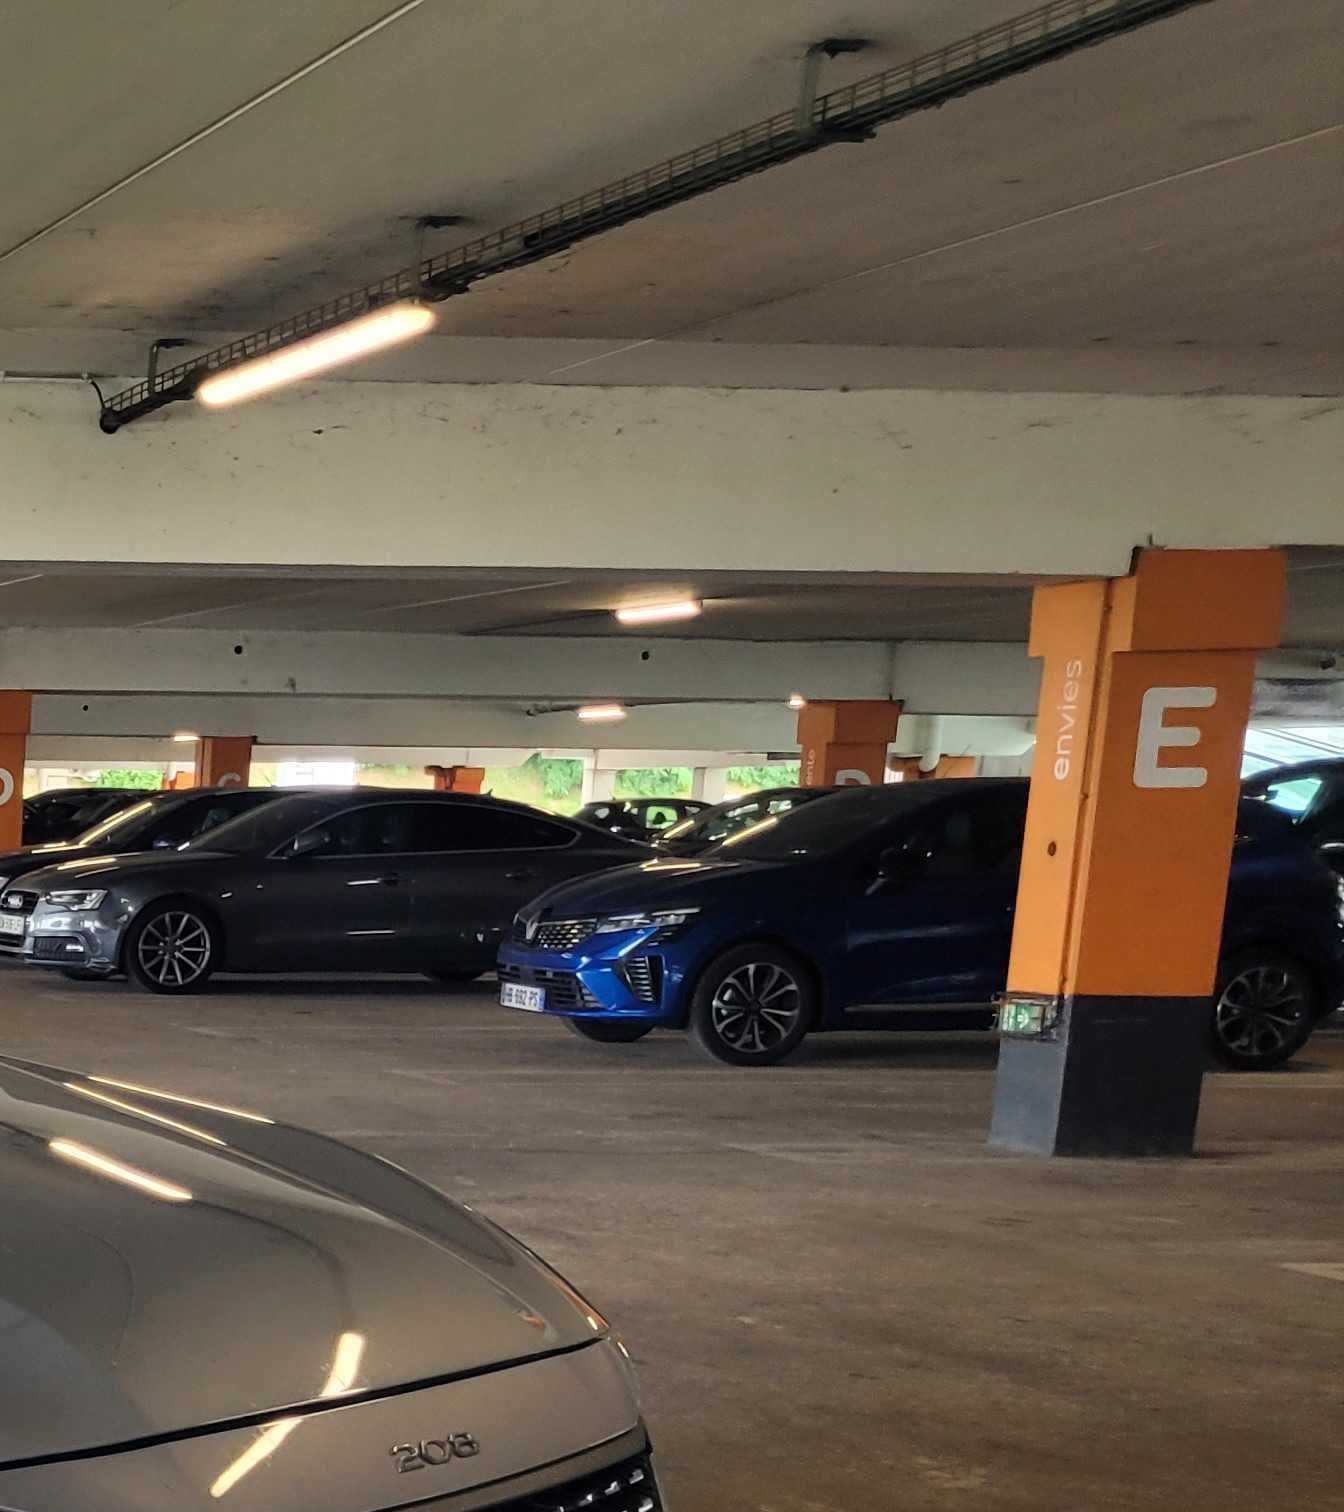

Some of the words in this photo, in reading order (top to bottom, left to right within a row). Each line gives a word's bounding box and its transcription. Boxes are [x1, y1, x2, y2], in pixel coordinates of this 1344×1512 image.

[1054, 659, 1082, 781] envies
[1133, 686, 1218, 788] E
[389, 1432, 480, 1473] 208
